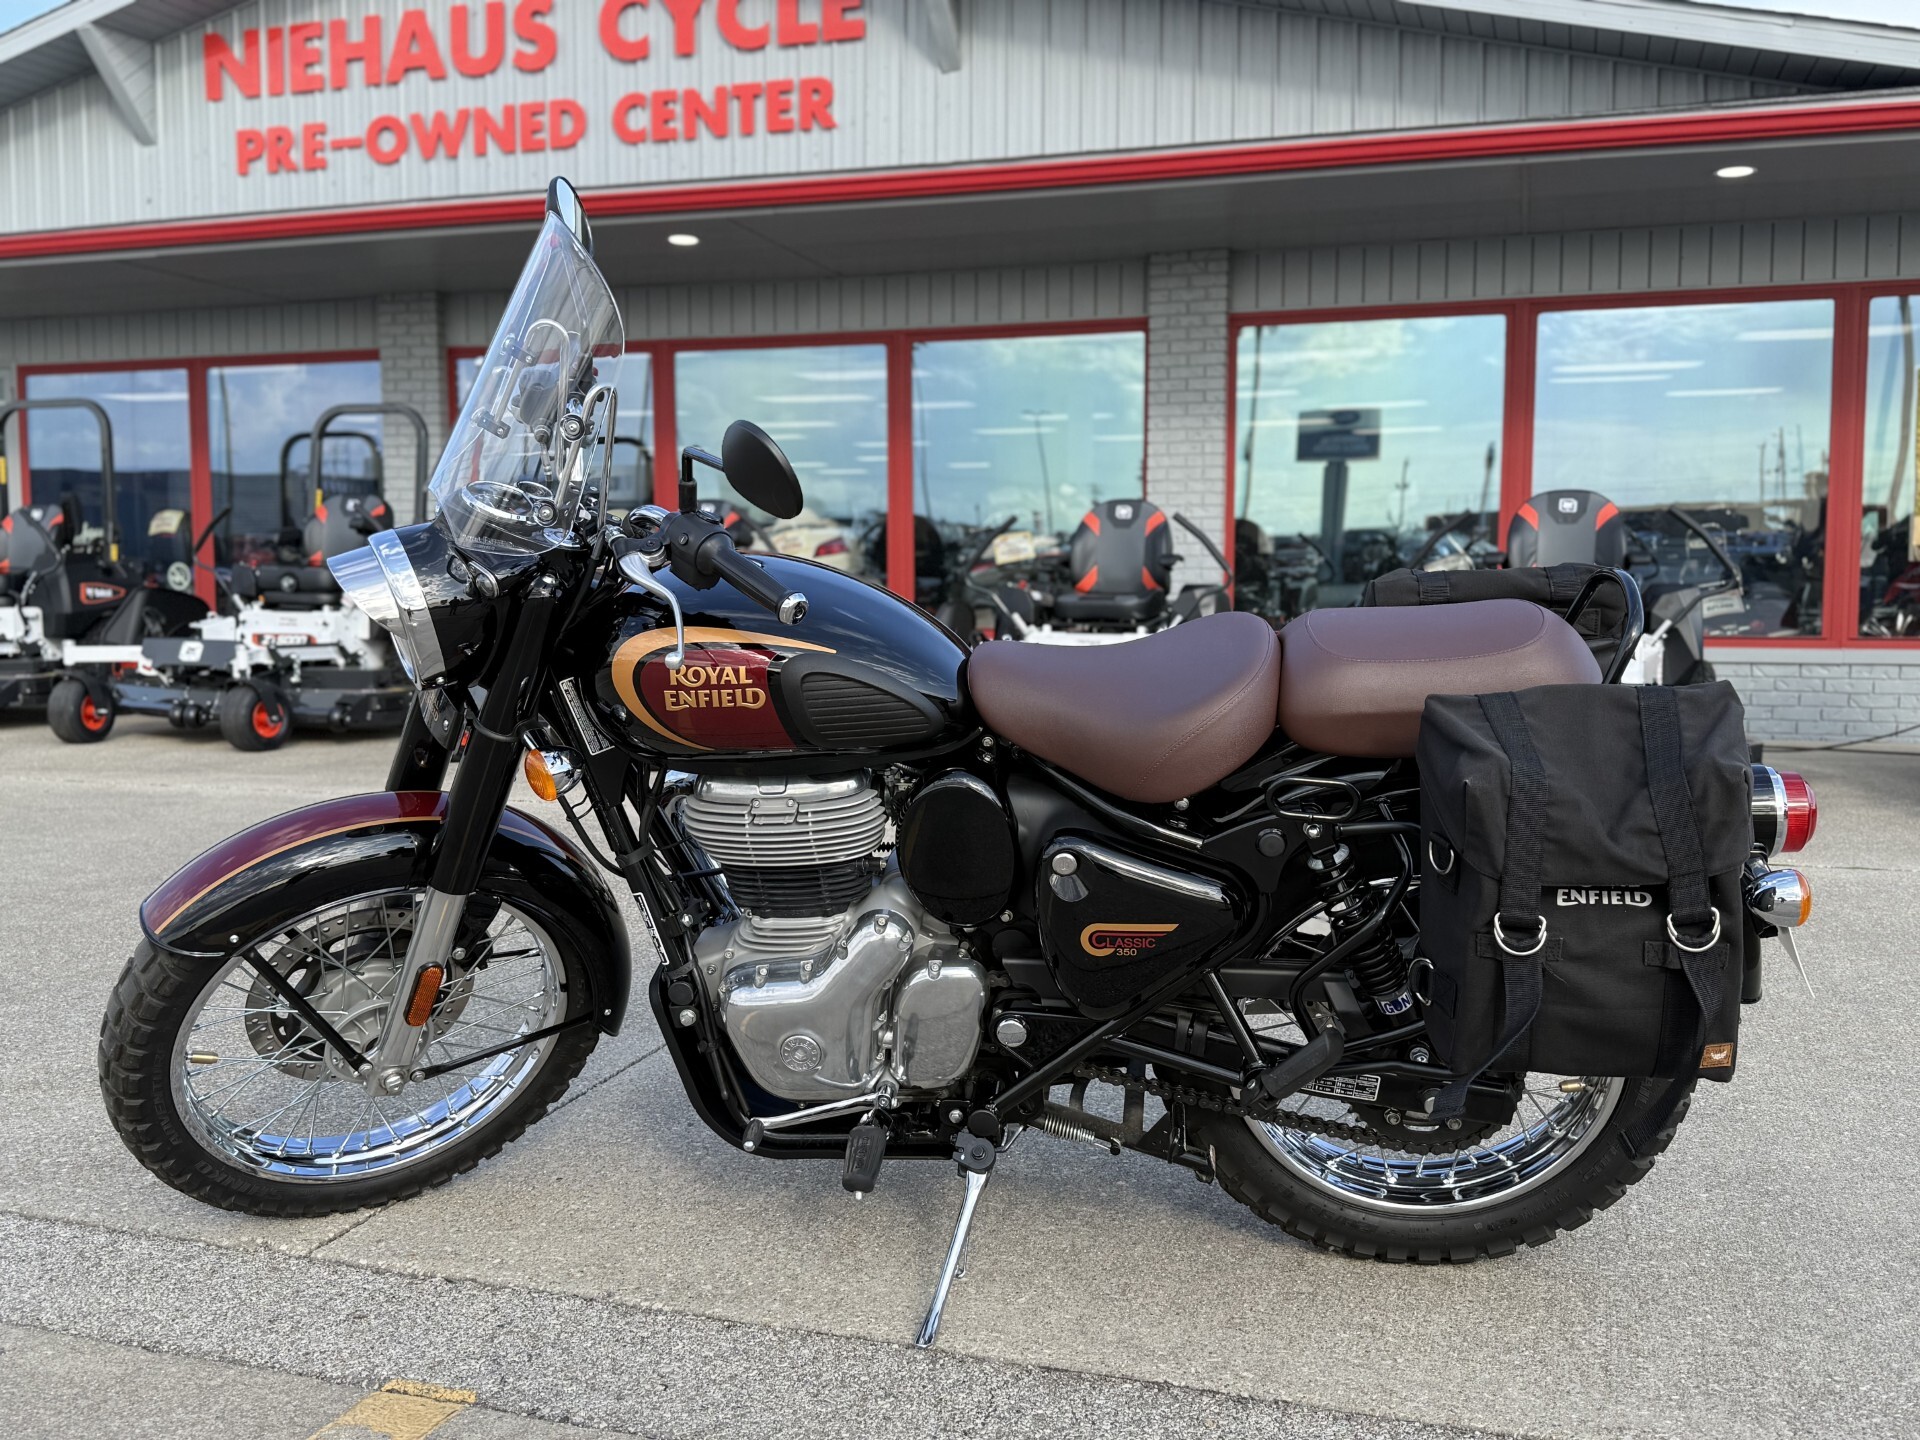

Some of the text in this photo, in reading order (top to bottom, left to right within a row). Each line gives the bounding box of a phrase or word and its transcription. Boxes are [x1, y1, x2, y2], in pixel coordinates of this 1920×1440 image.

[204, 0, 867, 102] NIEHAUS CYCLE
[236, 77, 836, 177] PRE-OWNED CENTER
[669, 664, 753, 688] ROYAL
[663, 687, 766, 711] ENFIELD
[1556, 889, 1653, 907] ENFIELD
[1091, 932, 1157, 949] CLASSIC
[1116, 948, 1137, 956] 350
